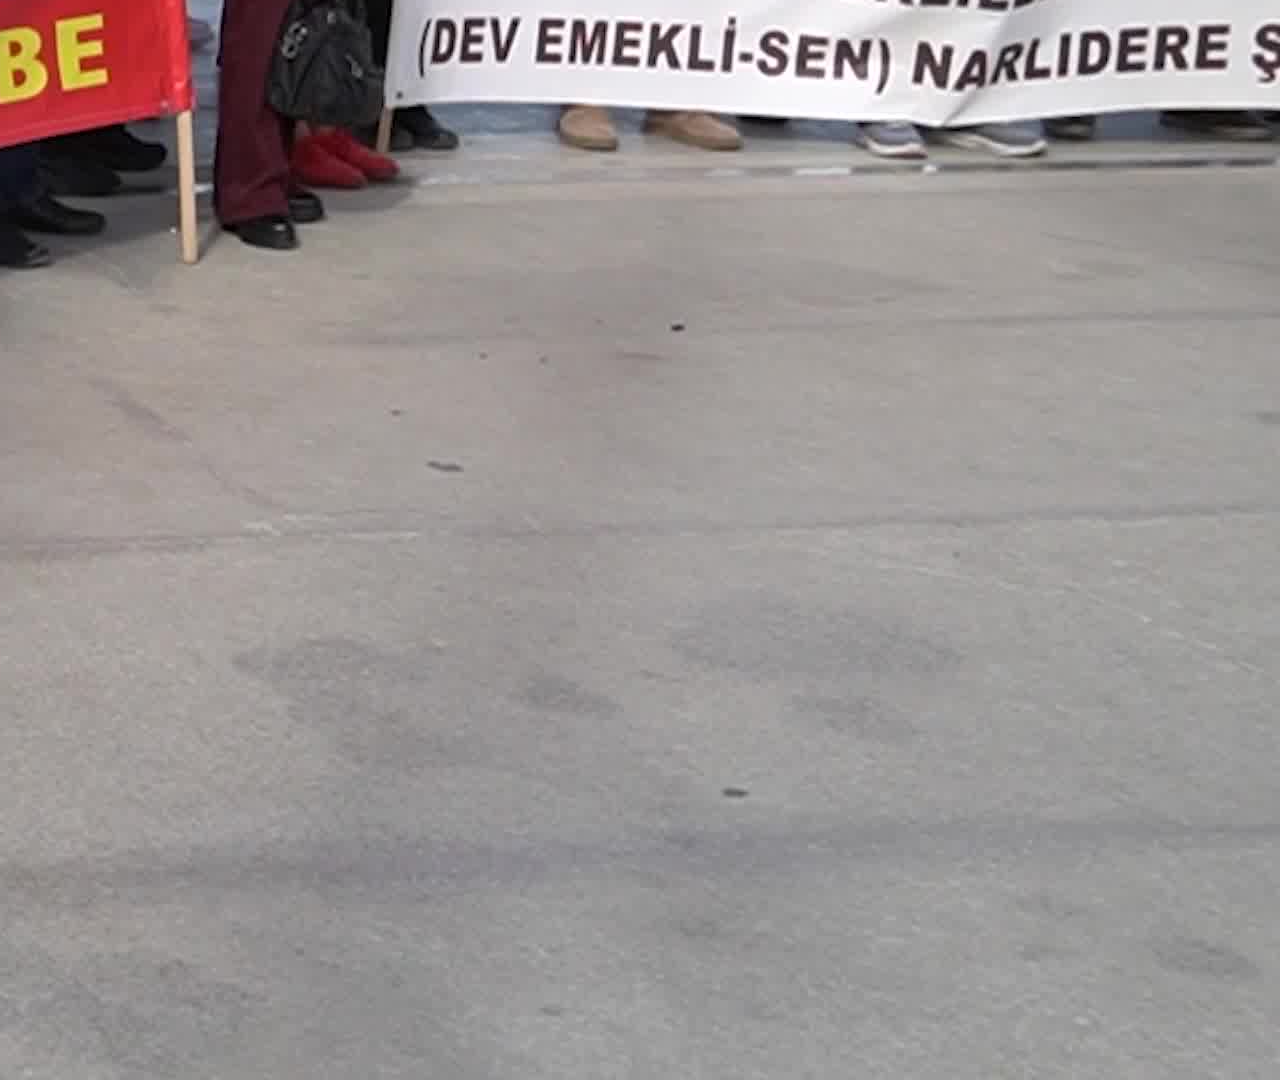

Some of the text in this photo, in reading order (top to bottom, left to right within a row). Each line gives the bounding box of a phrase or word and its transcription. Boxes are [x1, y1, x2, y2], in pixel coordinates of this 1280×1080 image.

[418, 17, 521, 78] (DEV
[535, 17, 892, 94] EMEKLİ-SEN)
[911, 23, 1231, 93] NARLIDERE
